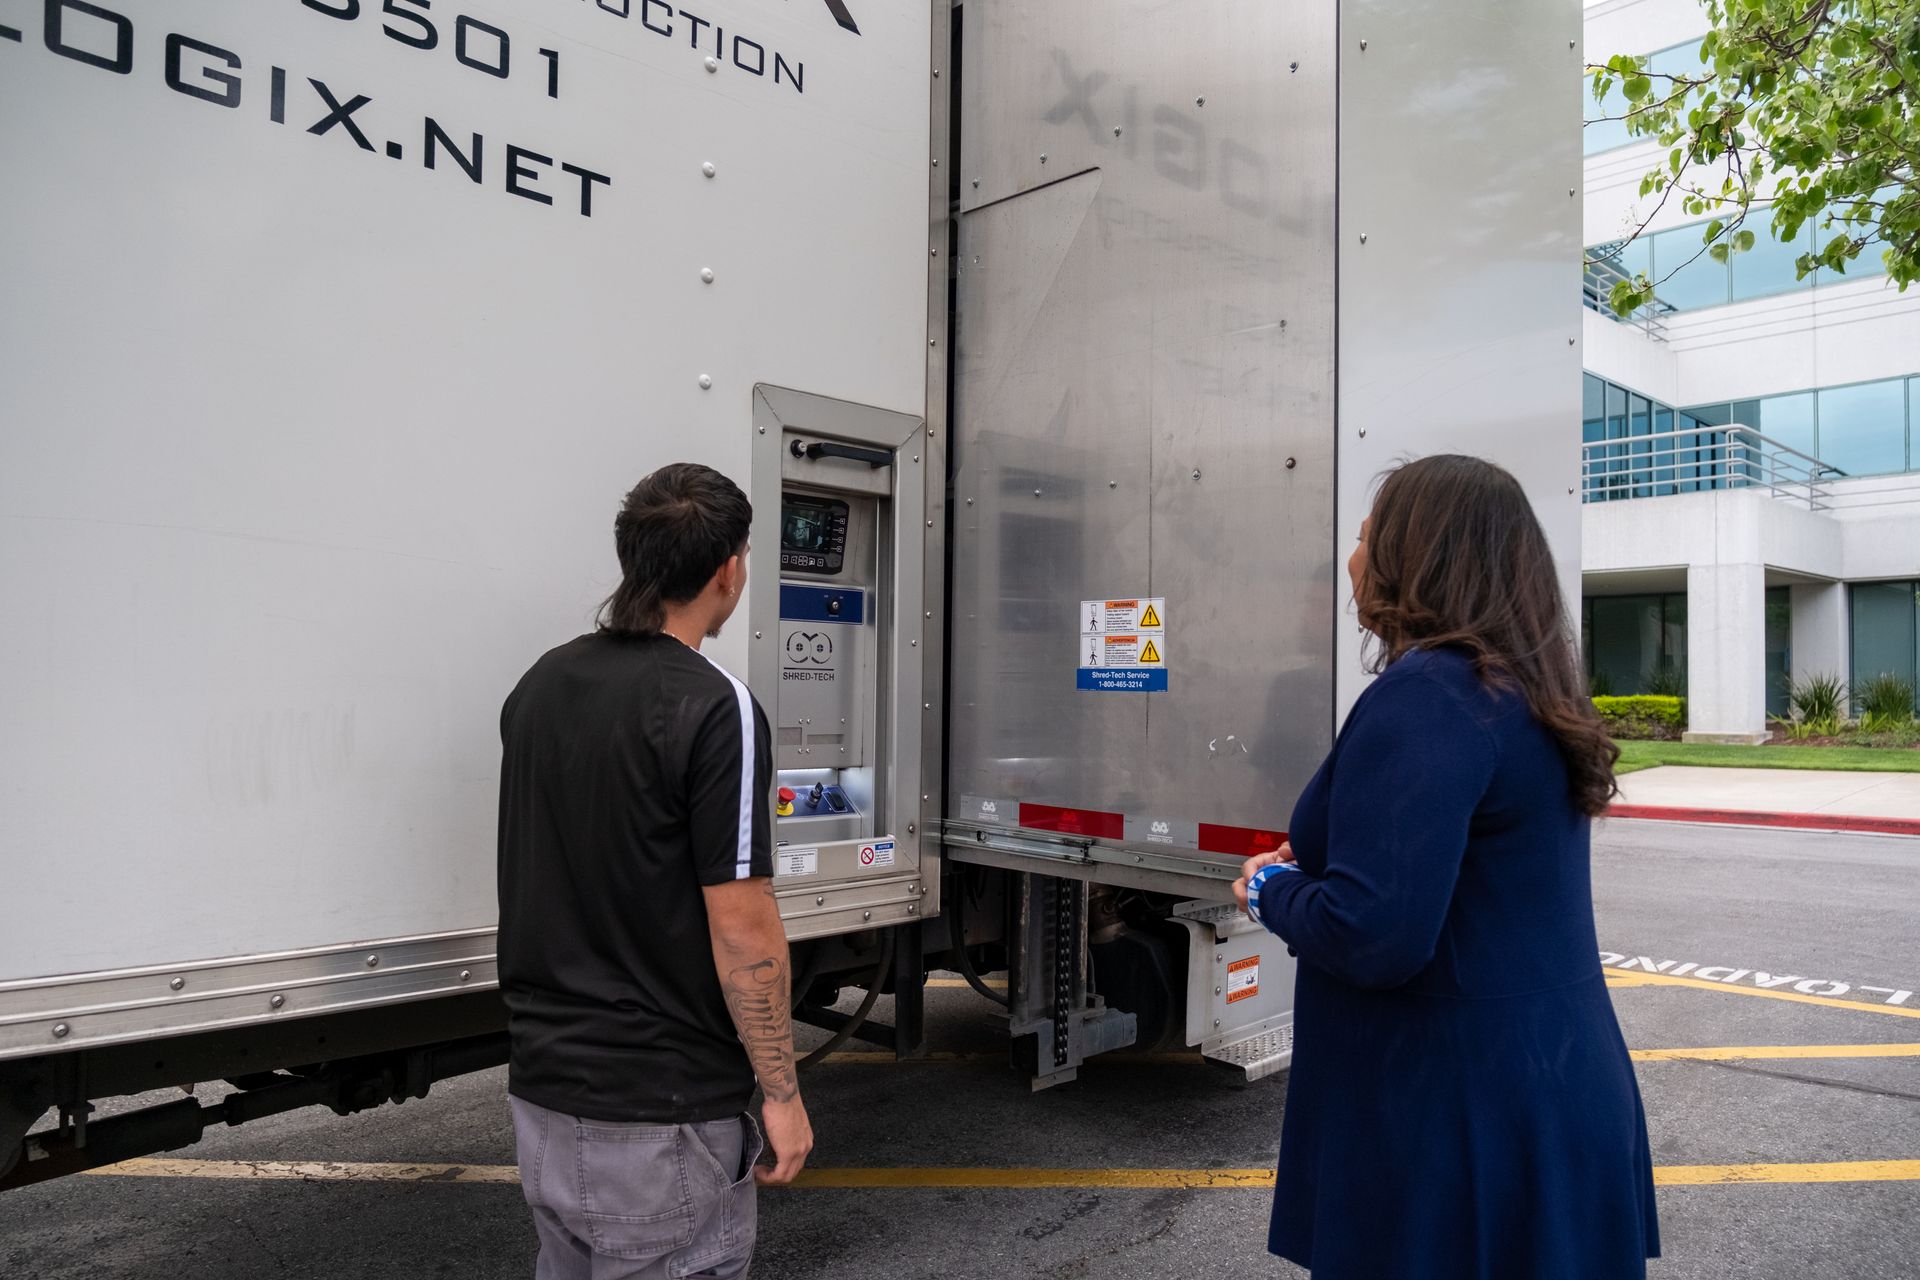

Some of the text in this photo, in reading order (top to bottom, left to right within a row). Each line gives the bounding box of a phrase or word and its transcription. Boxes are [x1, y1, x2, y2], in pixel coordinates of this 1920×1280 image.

[0, 0, 611, 218] OGIX.NET
[783, 671, 835, 682] SHRED-TECH
[1233, 957, 1258, 971] WARNING
[1232, 985, 1257, 1000] WARNING
